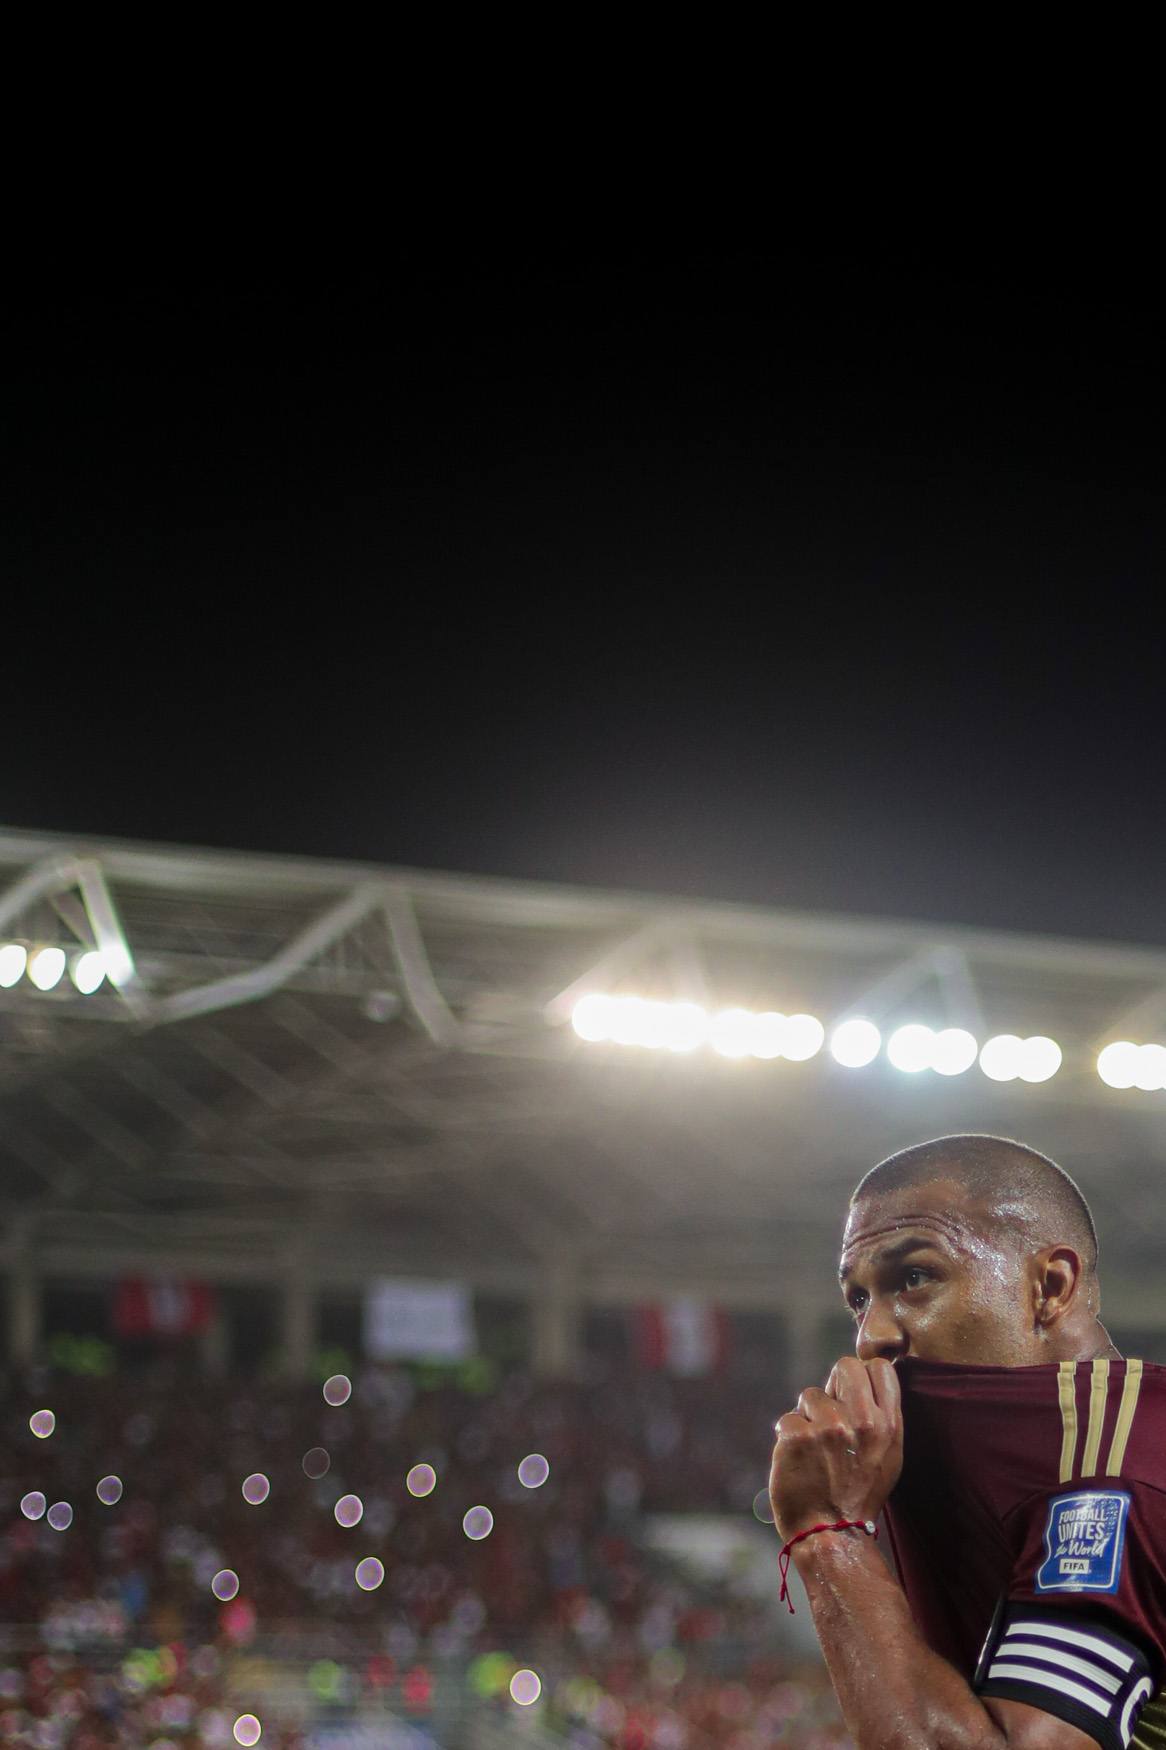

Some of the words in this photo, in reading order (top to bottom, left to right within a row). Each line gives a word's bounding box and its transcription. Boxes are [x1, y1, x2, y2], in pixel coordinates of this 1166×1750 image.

[1058, 1506, 1107, 1524] FOOTBALL
[1058, 1521, 1105, 1543] UNITES
[1067, 1538, 1110, 1558] World
[1063, 1562, 1085, 1571] FIFA
